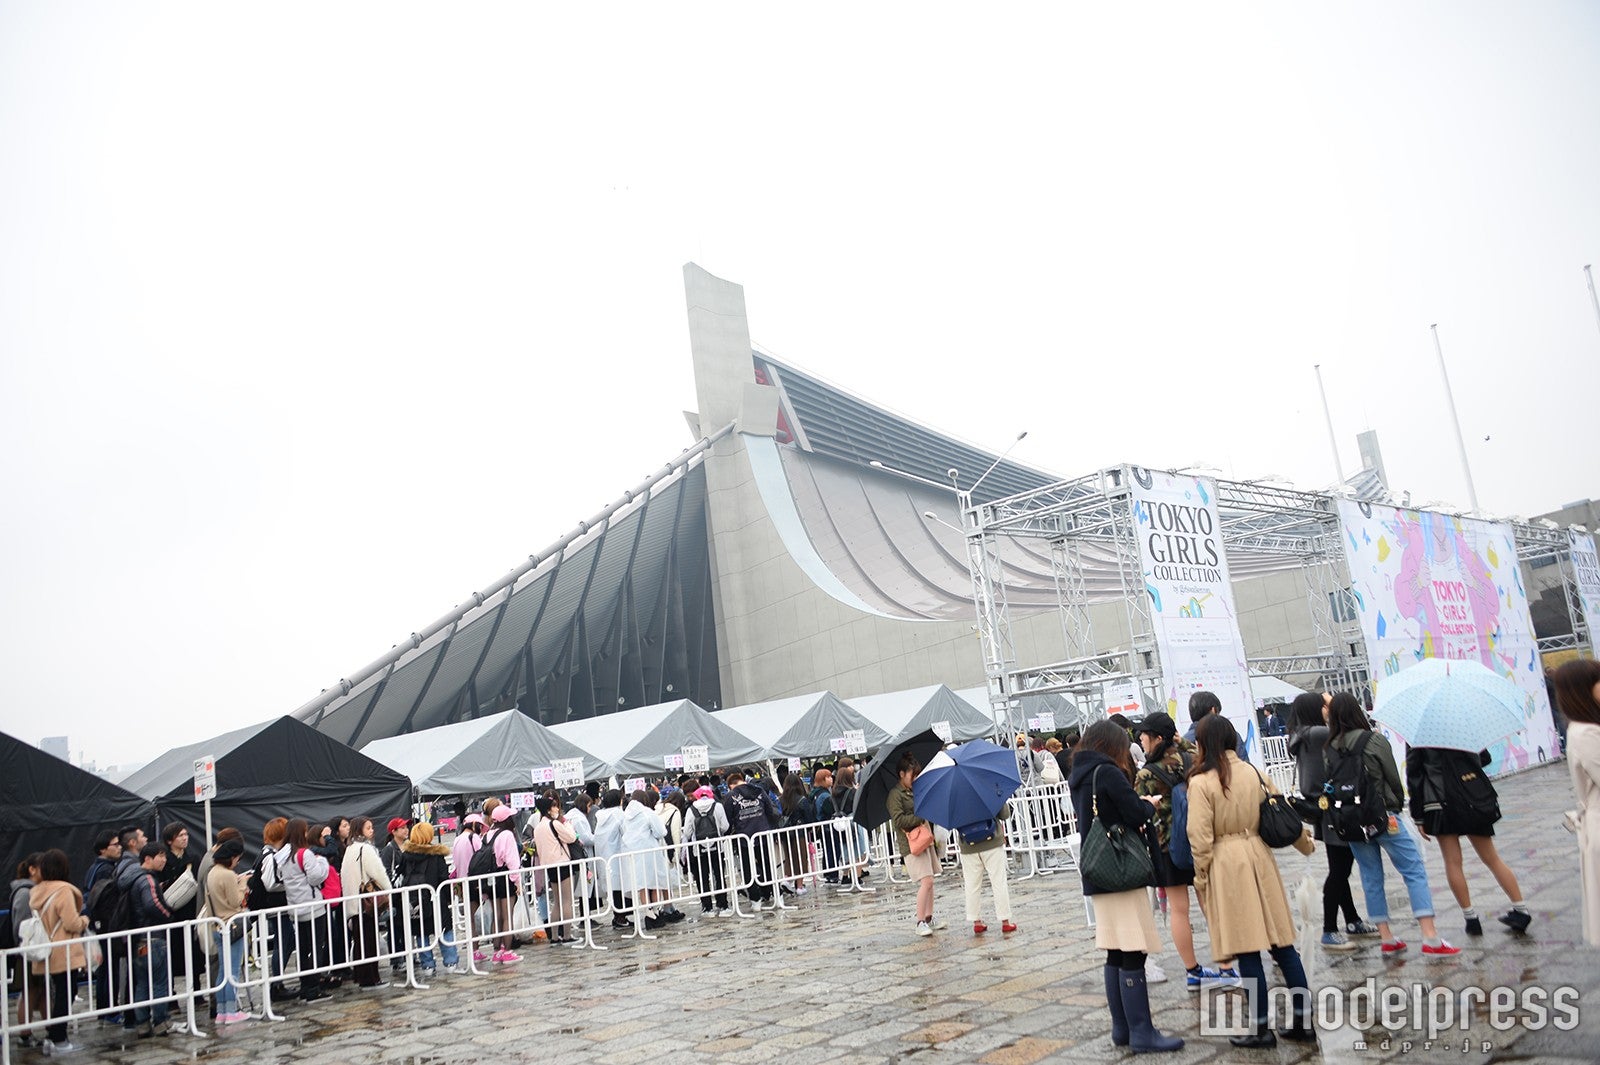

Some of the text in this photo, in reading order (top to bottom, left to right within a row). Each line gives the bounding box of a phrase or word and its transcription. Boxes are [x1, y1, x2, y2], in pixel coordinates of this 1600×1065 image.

[1141, 500, 1212, 536] TOKYO
[1149, 533, 1218, 567] GIRLS
[1154, 565, 1222, 583] COLLECTION
[1432, 580, 1466, 602] TOKYO
[1443, 605, 1467, 621] GIRLS
[1440, 622, 1475, 635] COLLECTION
